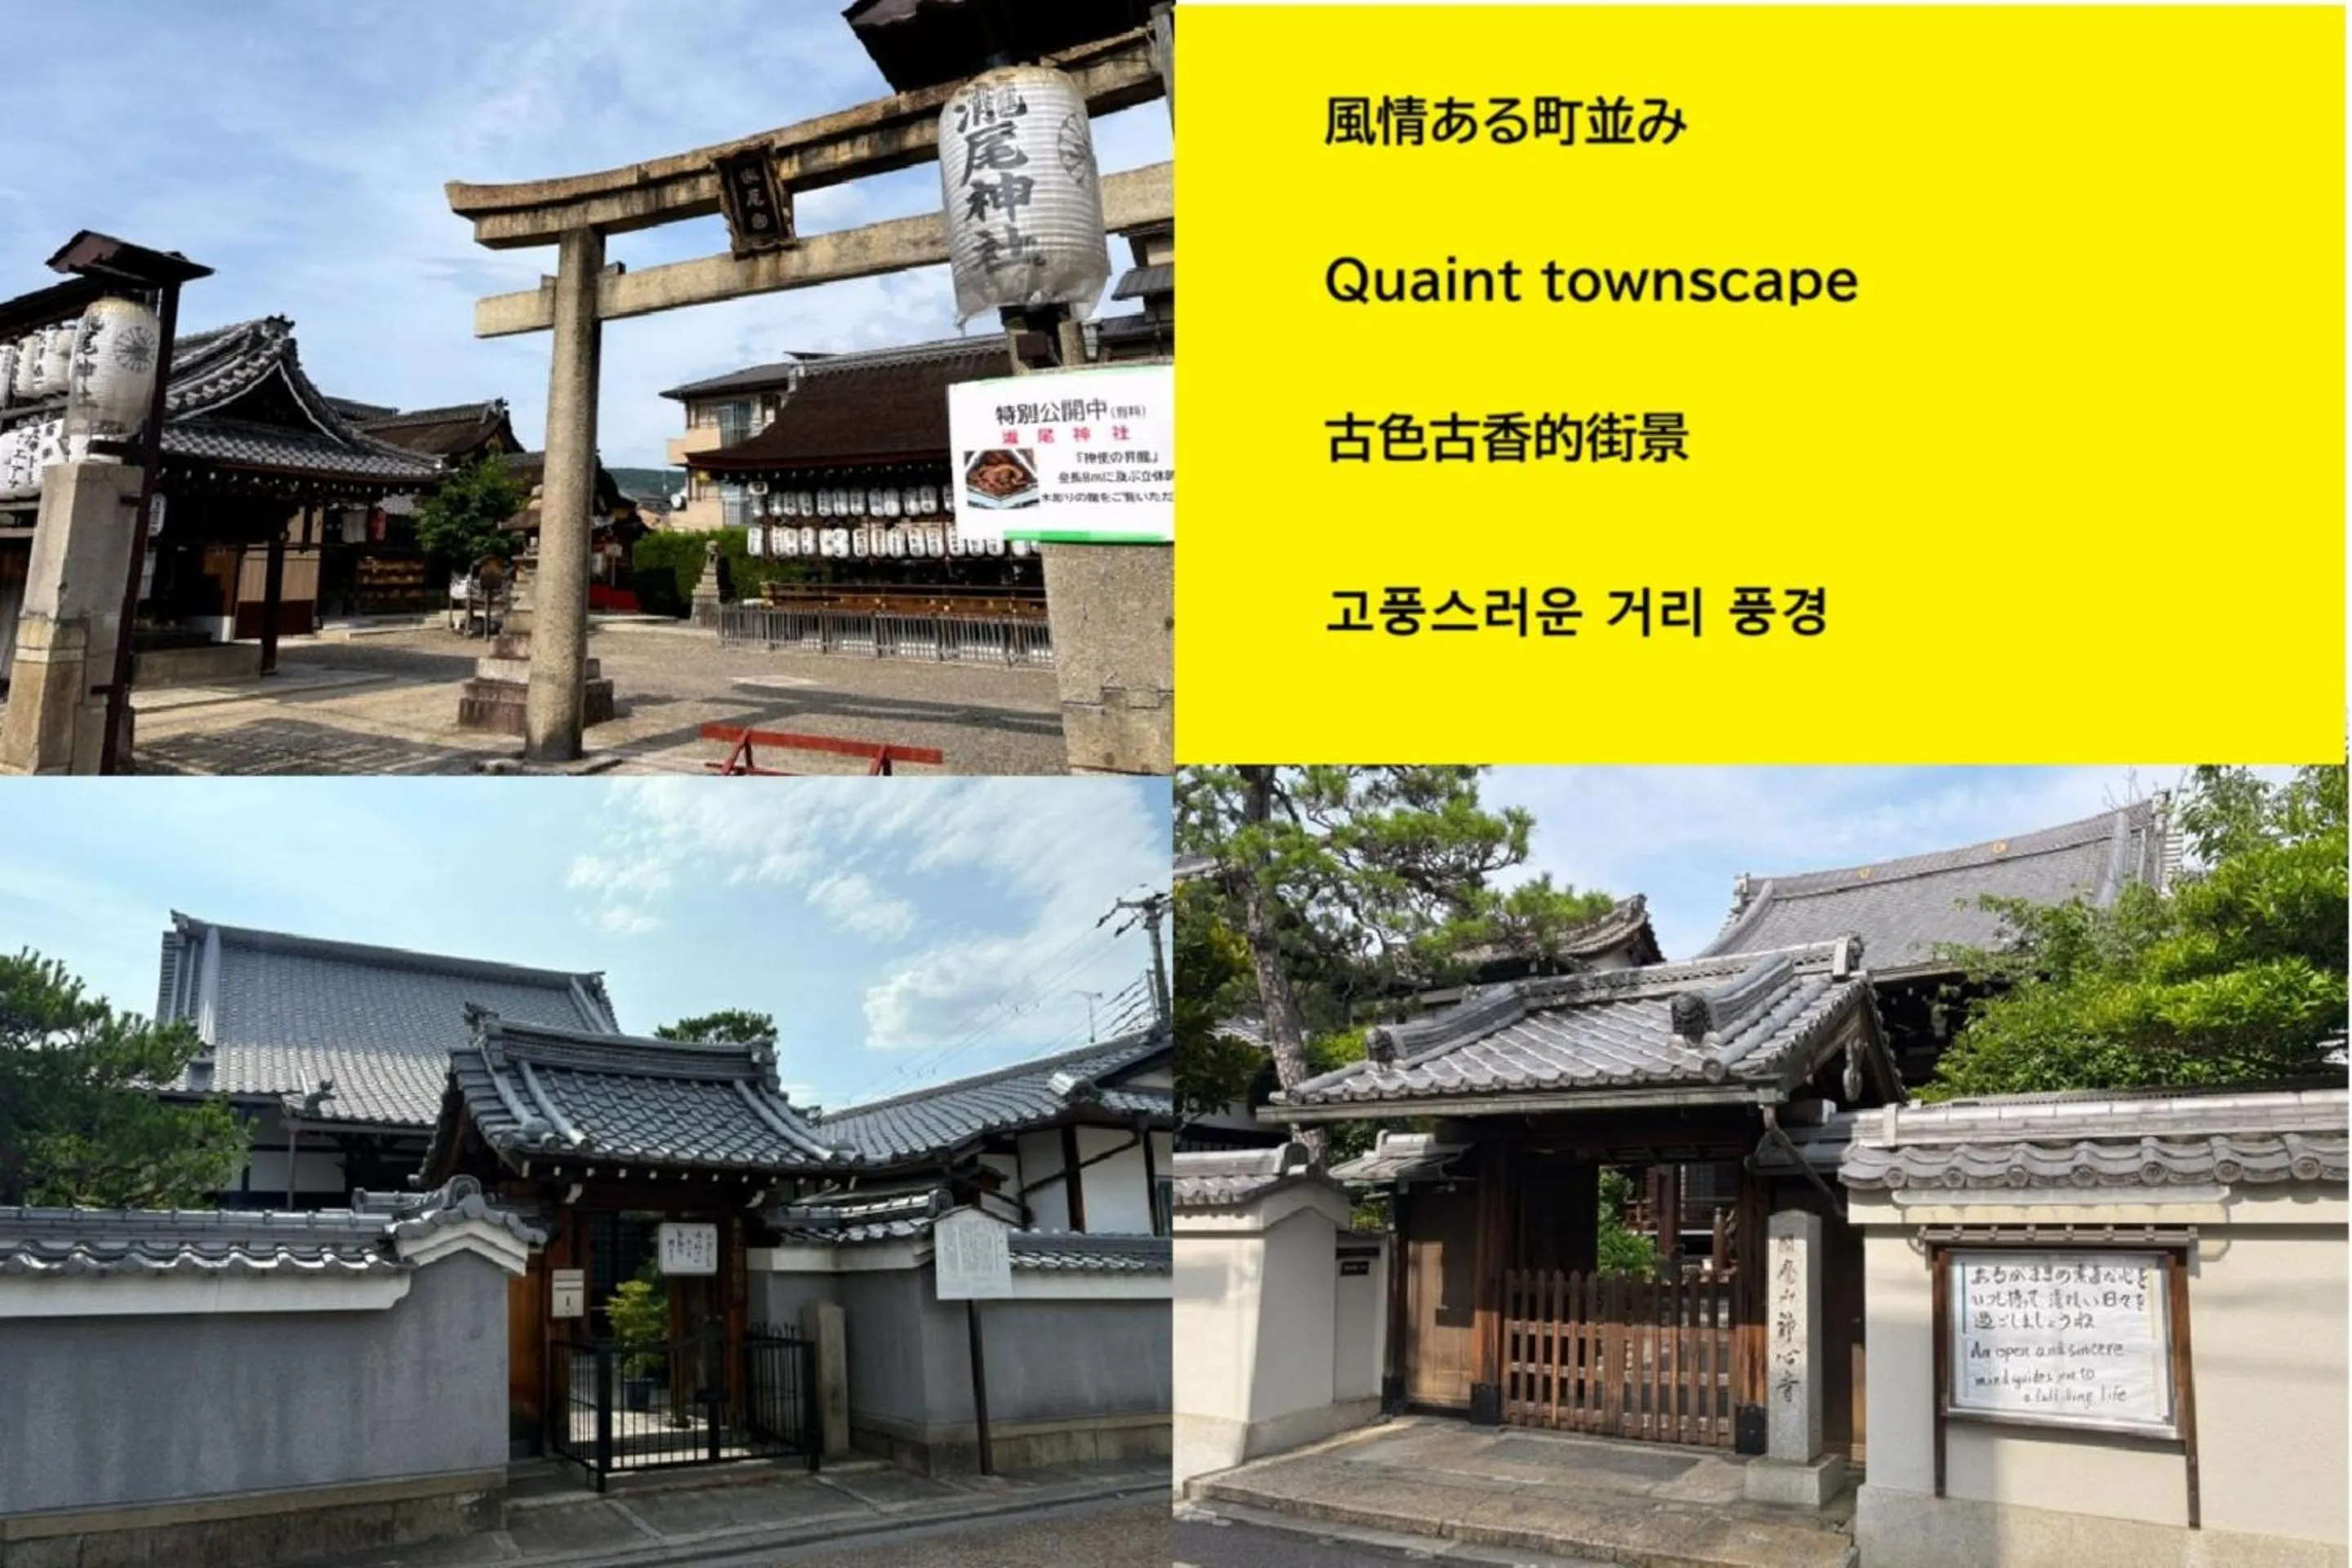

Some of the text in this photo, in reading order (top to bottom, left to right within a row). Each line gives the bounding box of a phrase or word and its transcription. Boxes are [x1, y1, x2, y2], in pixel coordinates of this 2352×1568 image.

[1971, 1341, 2124, 1362] An open and sincere
[1976, 1370, 2008, 1386] mind
[2079, 1367, 2096, 1381] to
[2100, 1384, 2127, 1402] life
